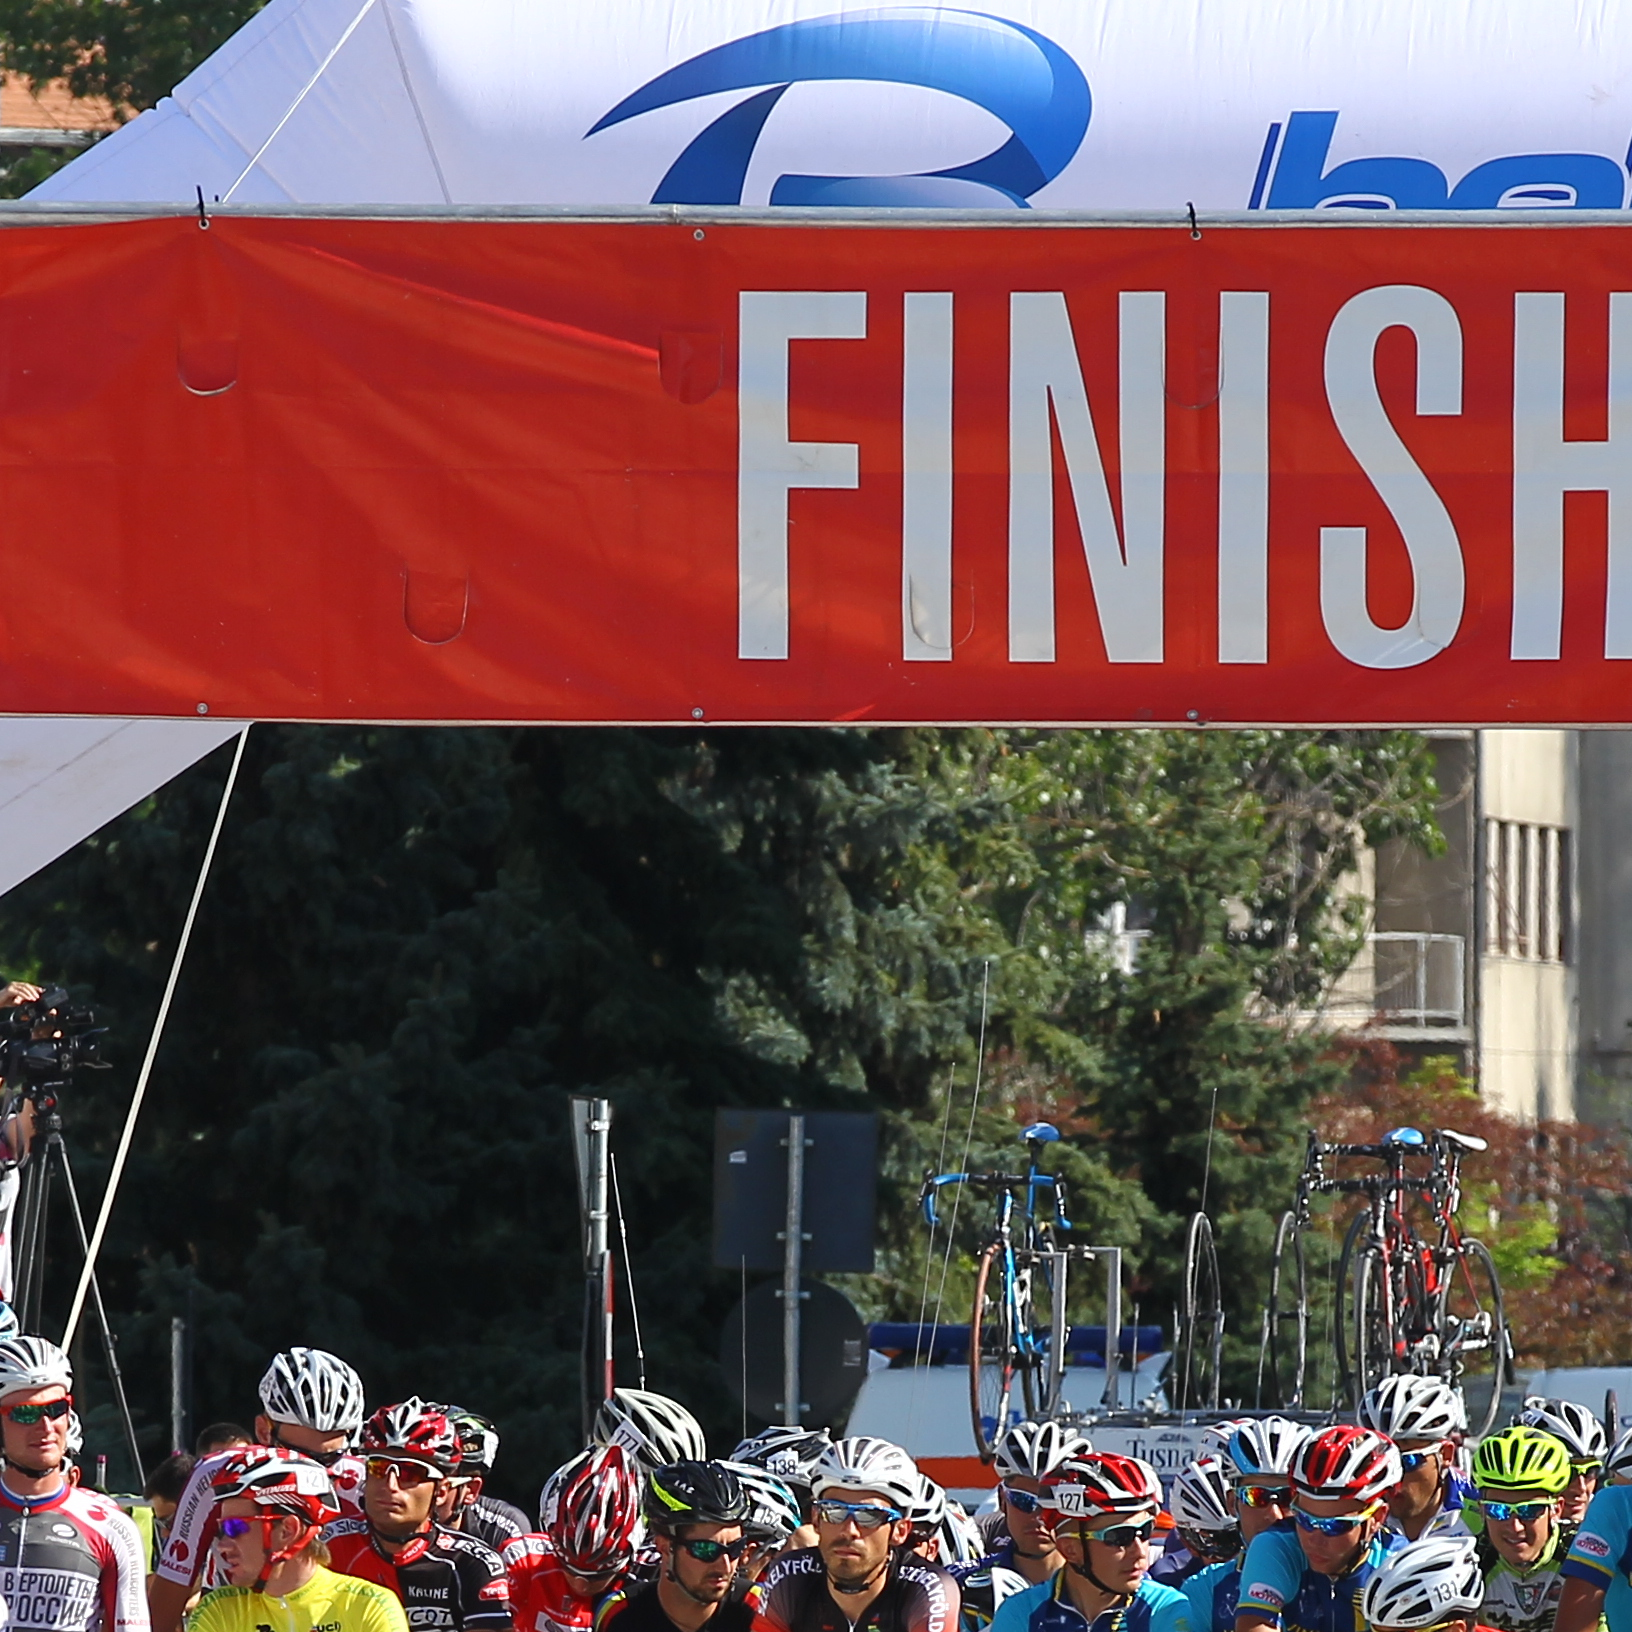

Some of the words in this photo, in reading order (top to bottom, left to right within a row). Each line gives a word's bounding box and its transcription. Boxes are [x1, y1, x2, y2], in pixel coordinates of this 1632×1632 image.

[771, 1459, 796, 1475] 138
[1059, 1492, 1081, 1512] 127
[1433, 1579, 1458, 1604] 131
